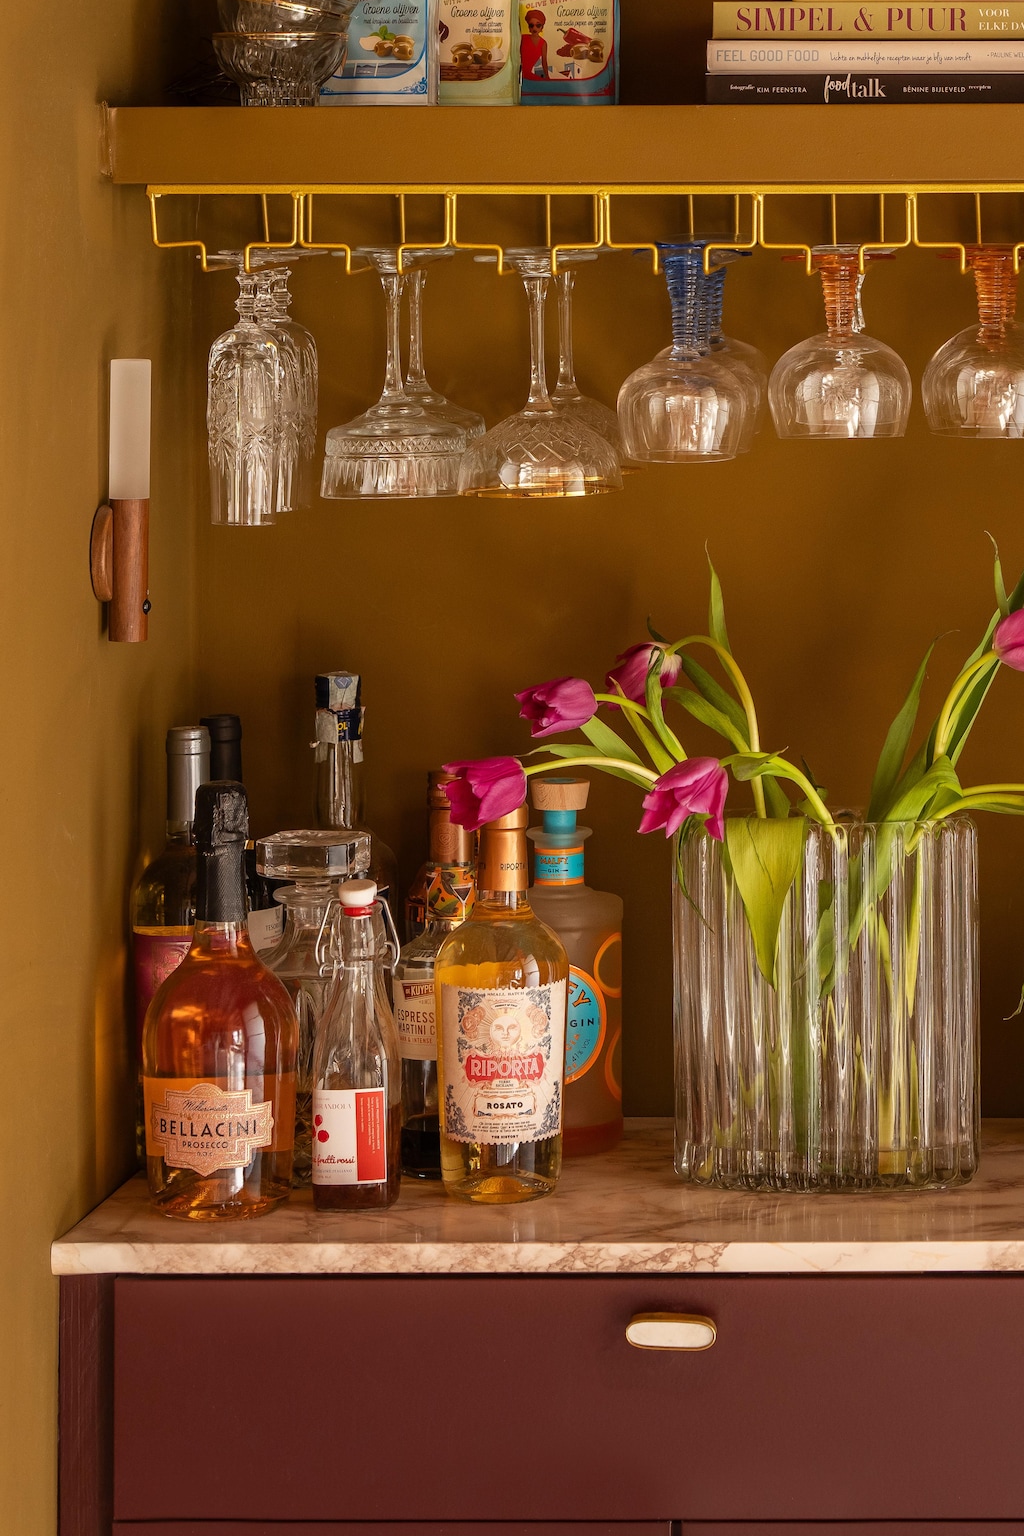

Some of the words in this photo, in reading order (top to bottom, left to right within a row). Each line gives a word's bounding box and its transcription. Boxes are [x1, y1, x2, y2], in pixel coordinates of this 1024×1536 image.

[362, 3, 391, 15] Groene
[392, 3, 420, 17] olijven
[525, 0, 547, 9] OLIVE
[450, 5, 478, 18] Groene
[479, 6, 505, 21] olijven
[556, 4, 585, 17] Groene
[586, 5, 608, 19] olijven
[978, 8, 1010, 17] VOOR
[736, 7, 843, 32] SIMPEL
[853, 6, 876, 32] &
[886, 7, 968, 32] PUUR
[978, 21, 1008, 30] ELKE
[716, 49, 747, 62] FEEL
[750, 49, 783, 62] GOOD
[786, 49, 819, 62] FOOD
[990, 51, 1013, 59] PAULINE
[902, 84, 929, 93] BÉNINE
[411, 983, 435, 996] KUYPE
[397, 1009, 435, 1024] ESPRESS
[569, 1017, 595, 1027] GIN
[470, 1057, 540, 1077] RIPORTA
[486, 1101, 524, 1110] ROSATO
[160, 1118, 257, 1138] BELLACINI
[182, 1141, 229, 1149] PROSECCO
[336, 1156, 355, 1164] rossi
